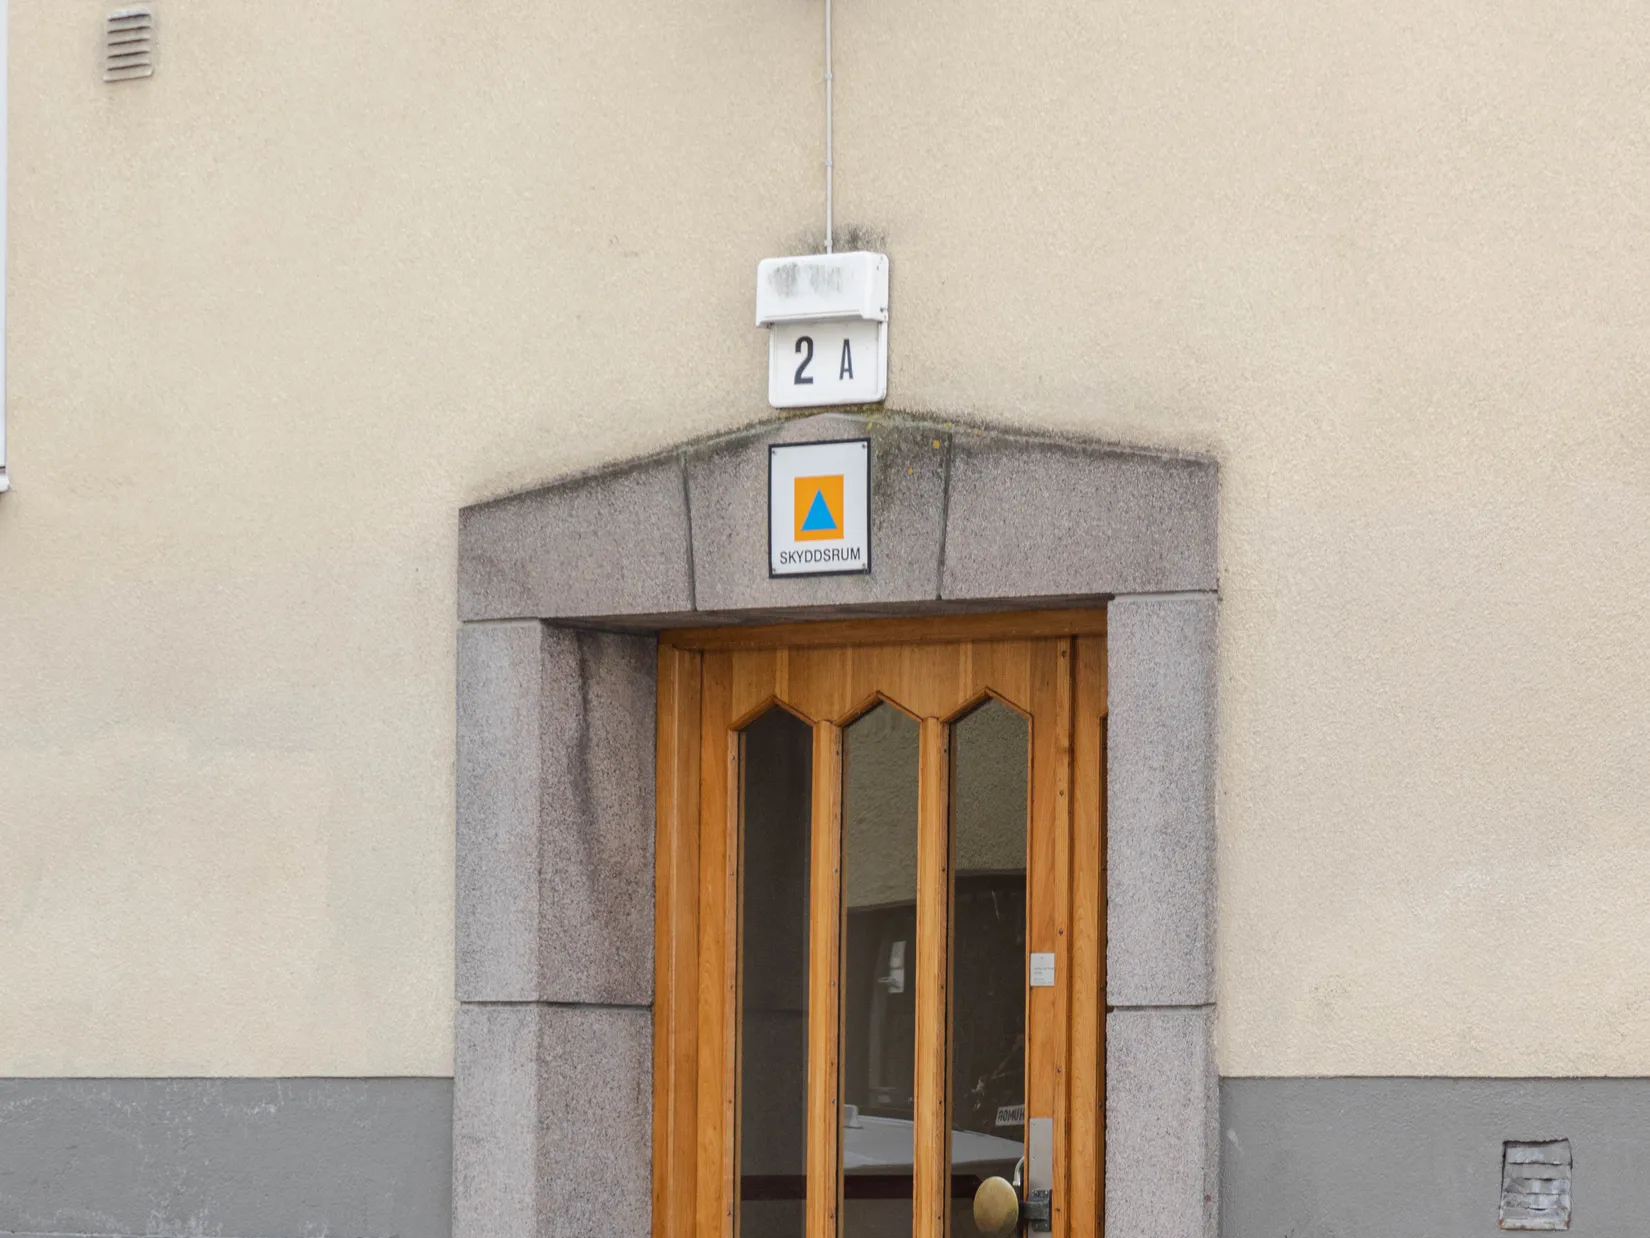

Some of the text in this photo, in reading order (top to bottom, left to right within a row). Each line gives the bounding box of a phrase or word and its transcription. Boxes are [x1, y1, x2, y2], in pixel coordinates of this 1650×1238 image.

[794, 336, 853, 385] 2 A
[780, 547, 861, 565] SKYDDSRUM
